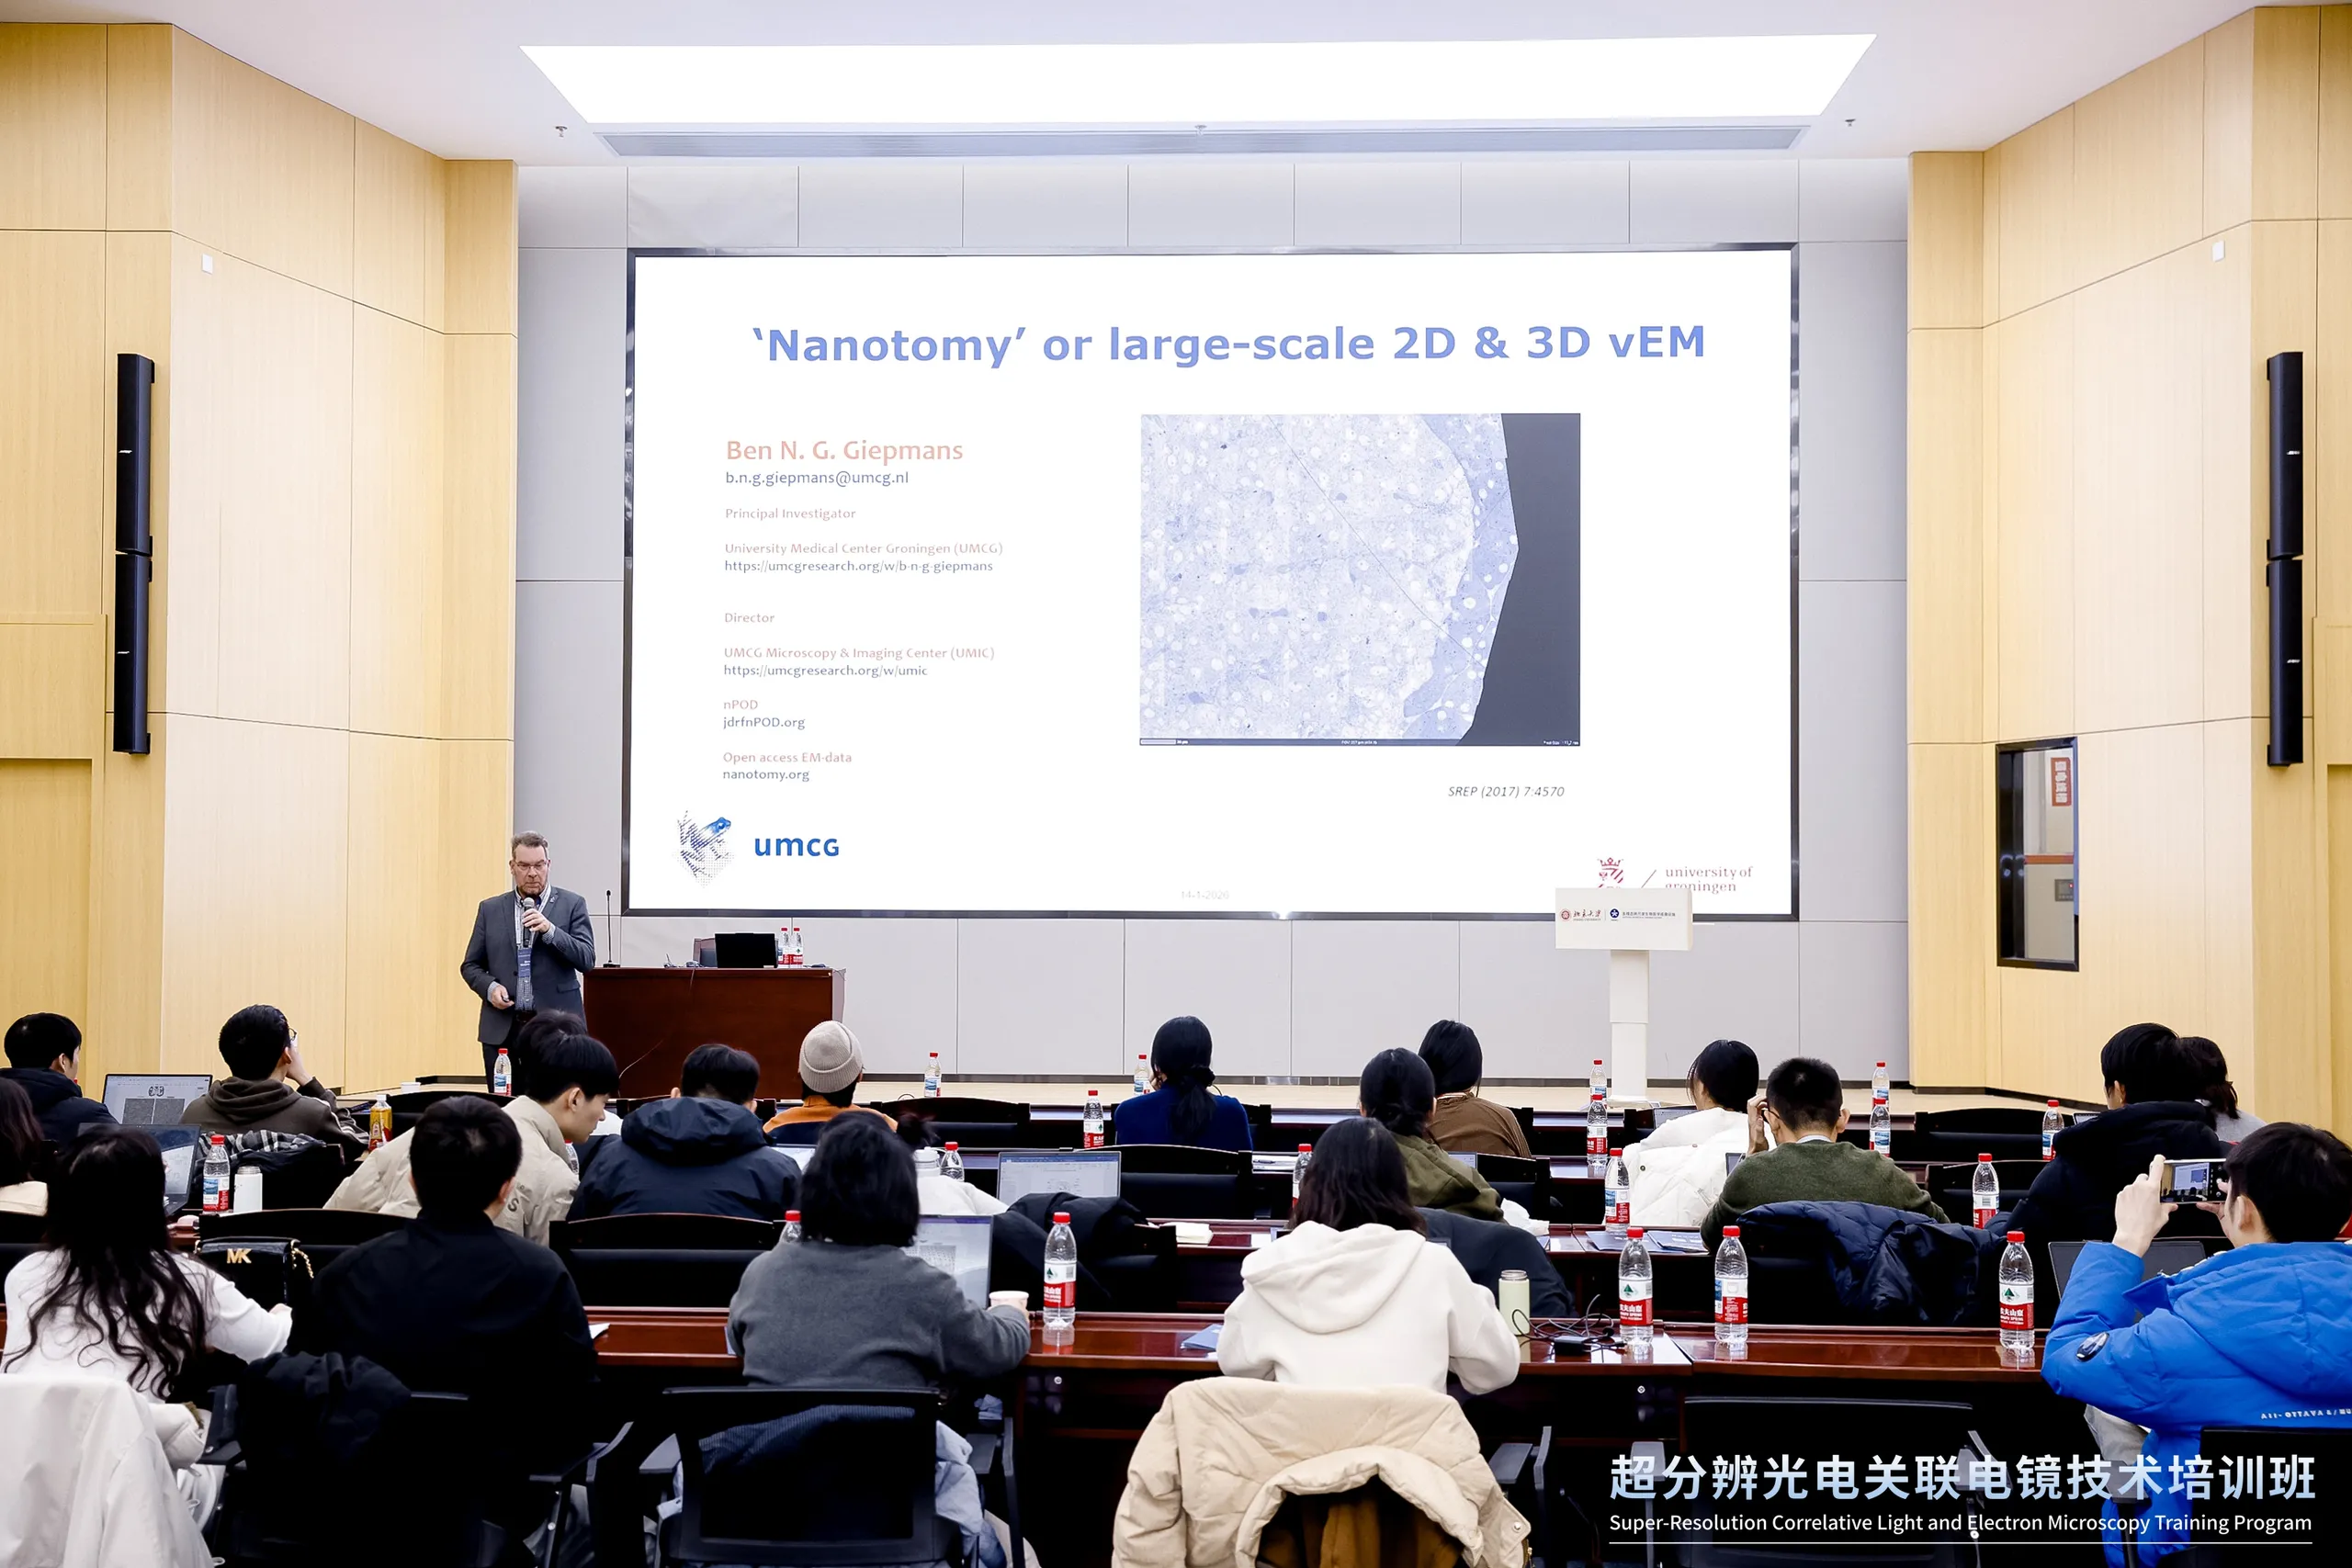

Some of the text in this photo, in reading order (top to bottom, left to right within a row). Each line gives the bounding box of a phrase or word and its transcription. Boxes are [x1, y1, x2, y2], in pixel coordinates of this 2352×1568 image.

[1044, 336, 1092, 360] or
[1111, 326, 1374, 368] large-scale
[1394, 327, 1455, 359] 2D
[1475, 326, 1510, 359] &
[1528, 326, 1589, 358] 3D
[1609, 325, 1704, 358] vEM
[727, 440, 963, 465] Ben N. G. Giepmans
[725, 471, 909, 486] b.n.g.giepmans@umcg.nl
[725, 508, 856, 522] Principal Investigator
[725, 542, 1003, 557] University Medical Center Groningen (UMCG)
[724, 612, 775, 624] Director
[724, 647, 995, 661] UMCG Microscopy & Imaging Center (UMIC)
[724, 664, 928, 678] https://umcgresearch.org/w/umic
[723, 699, 759, 711] nPOD
[723, 716, 806, 730] jdrfnPOD.org
[723, 751, 853, 765] Open access EM-data
[723, 770, 810, 783] nanotomy.org
[1448, 785, 1565, 799] SREP (2017) 7:4570
[1666, 866, 1753, 880] university of
[226, 1247, 253, 1264] MK
